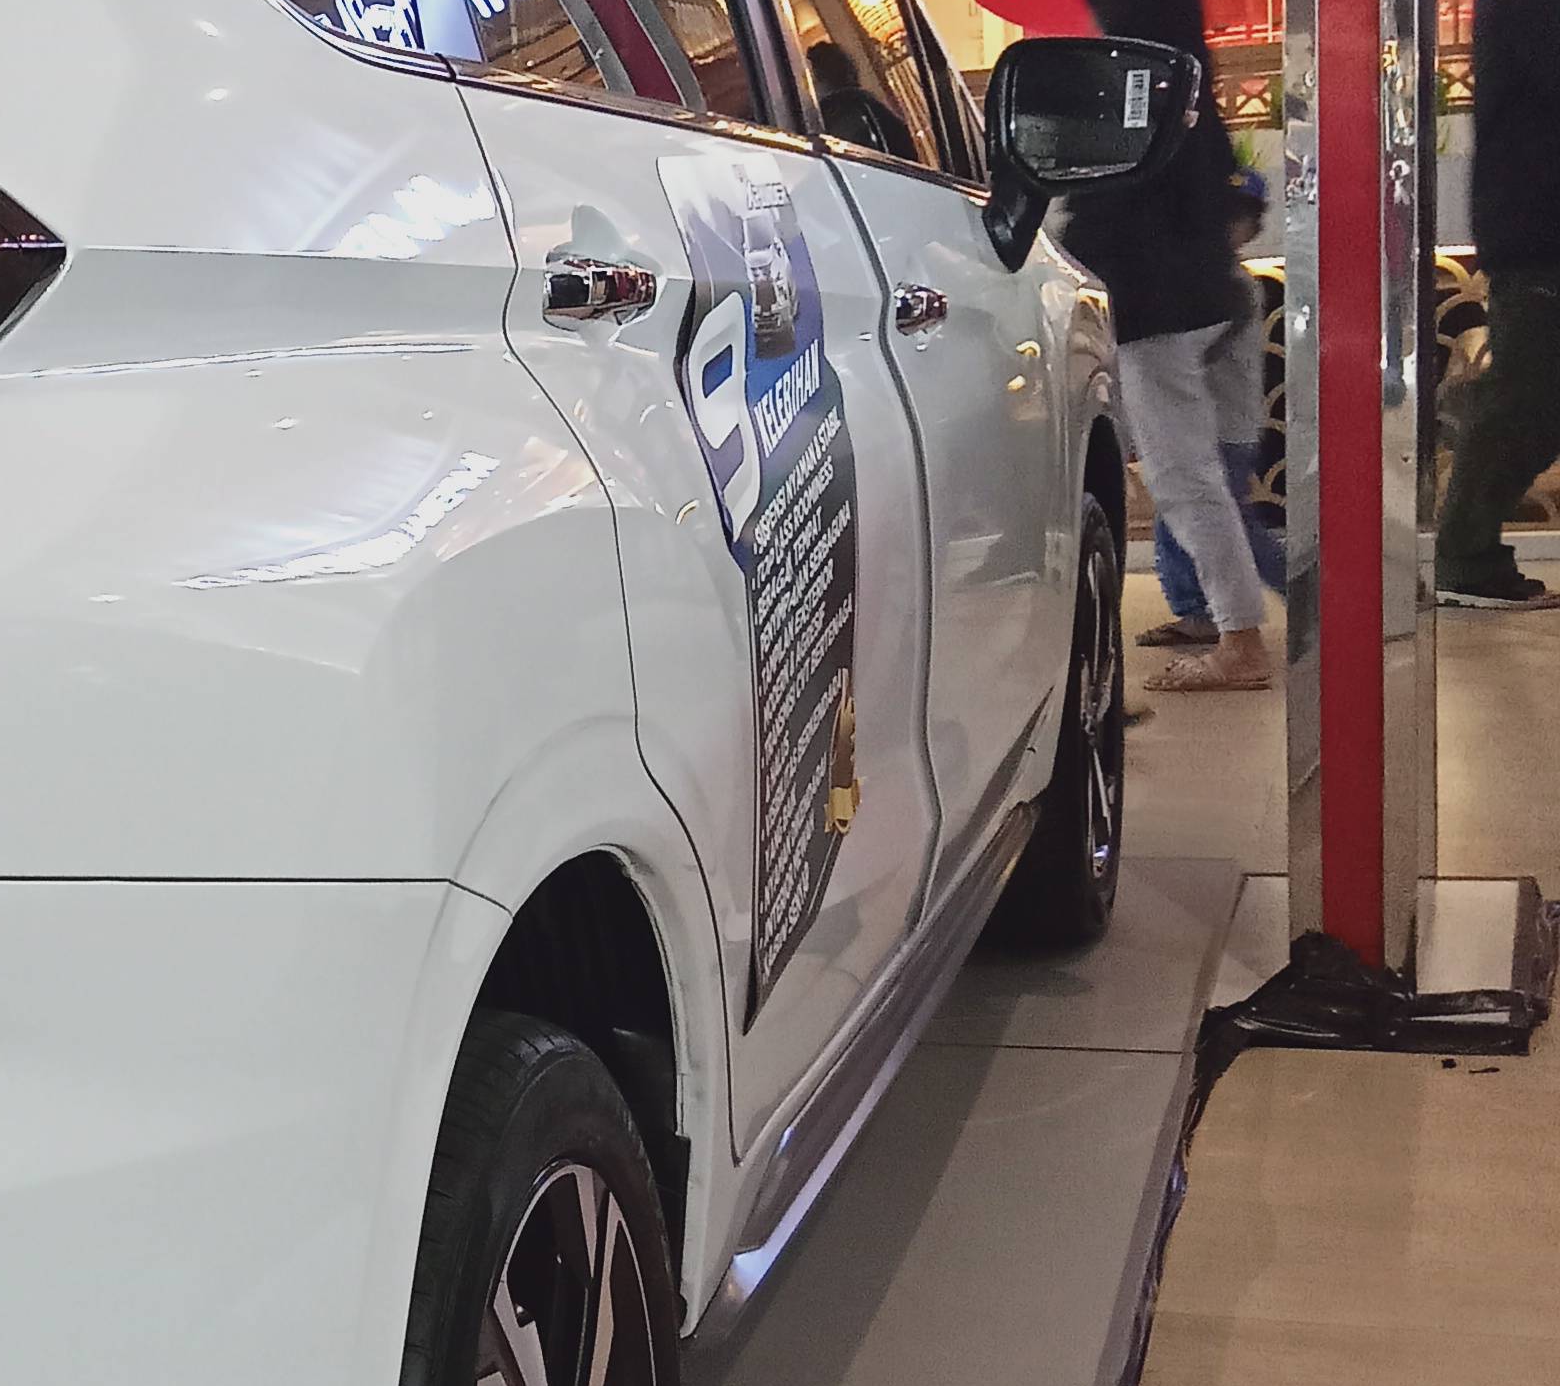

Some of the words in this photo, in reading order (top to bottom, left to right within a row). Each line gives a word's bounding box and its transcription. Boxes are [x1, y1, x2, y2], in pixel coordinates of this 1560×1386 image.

[753, 338, 821, 459] KELEBIHAN
[787, 446, 816, 505] NYAMAN
[794, 454, 835, 531] ROOMINESS
[793, 505, 822, 566] TEMPAT
